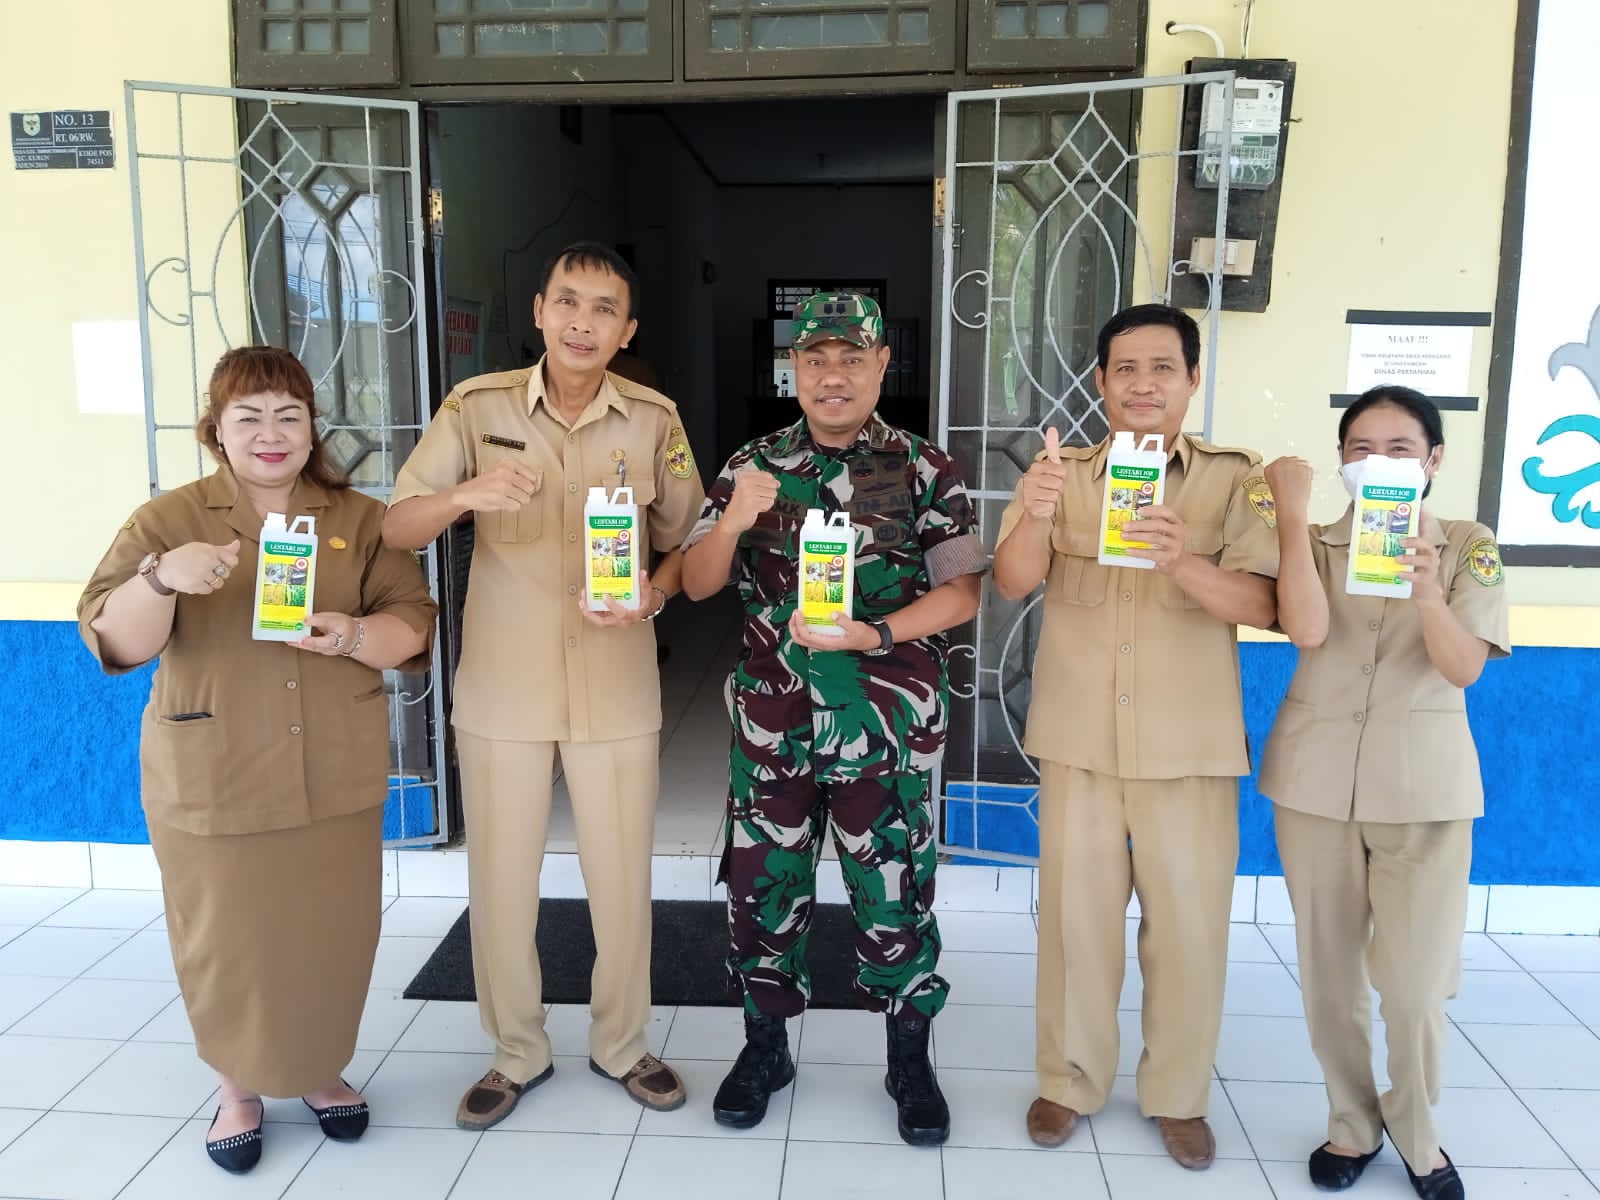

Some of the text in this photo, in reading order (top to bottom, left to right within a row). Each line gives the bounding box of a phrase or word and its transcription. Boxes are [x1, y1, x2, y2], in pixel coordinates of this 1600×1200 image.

[55, 114, 94, 126] NO. 13
[55, 133, 68, 143] RT.
